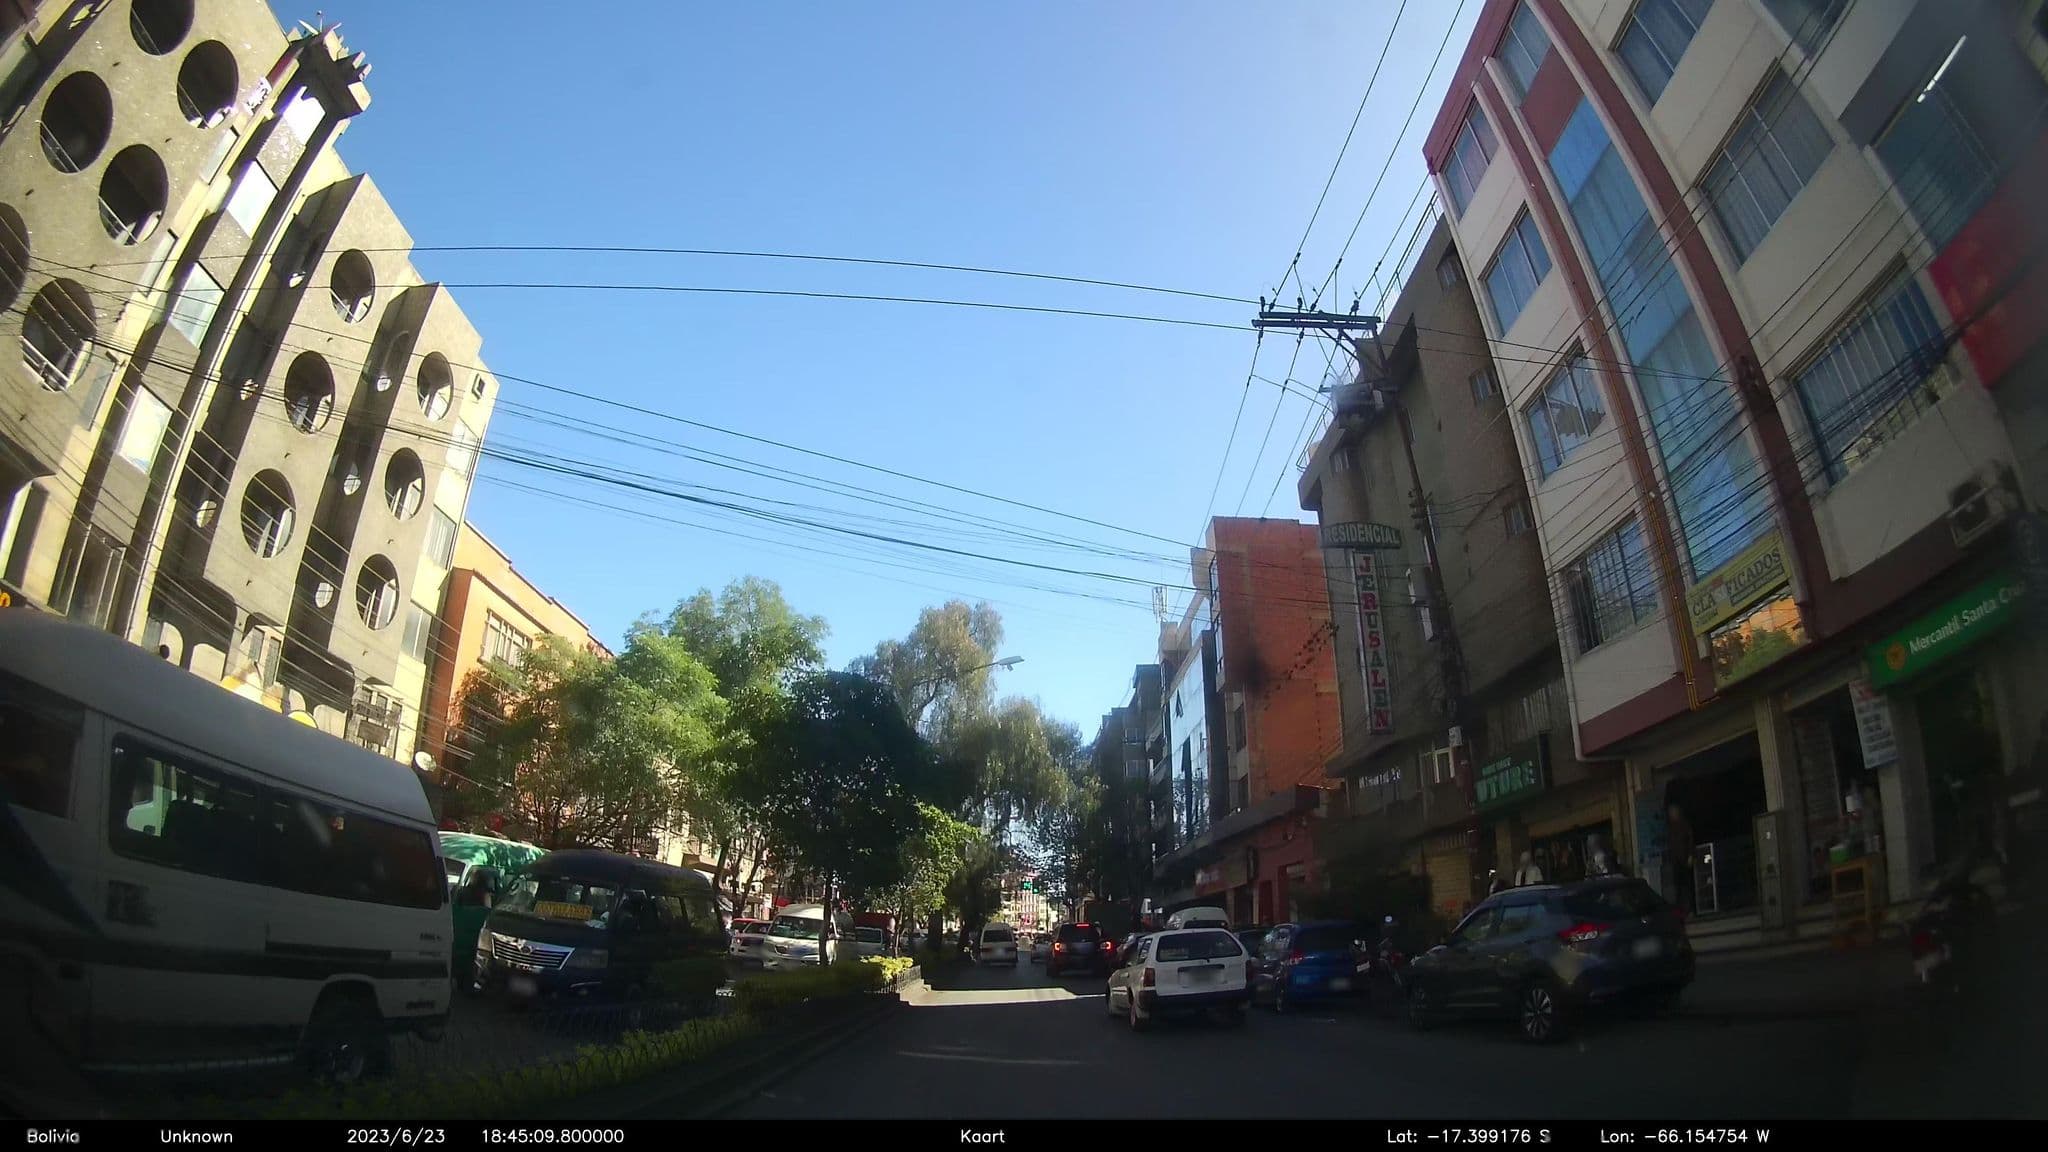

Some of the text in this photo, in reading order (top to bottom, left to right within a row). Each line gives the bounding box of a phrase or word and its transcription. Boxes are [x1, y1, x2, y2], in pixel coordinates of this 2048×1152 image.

[1323, 523, 1401, 546] RESIDENCIAL
[1357, 556, 1391, 729] JERUSALEN
[1909, 615, 1961, 655] Mercantil
[1961, 598, 1998, 628] Santa
